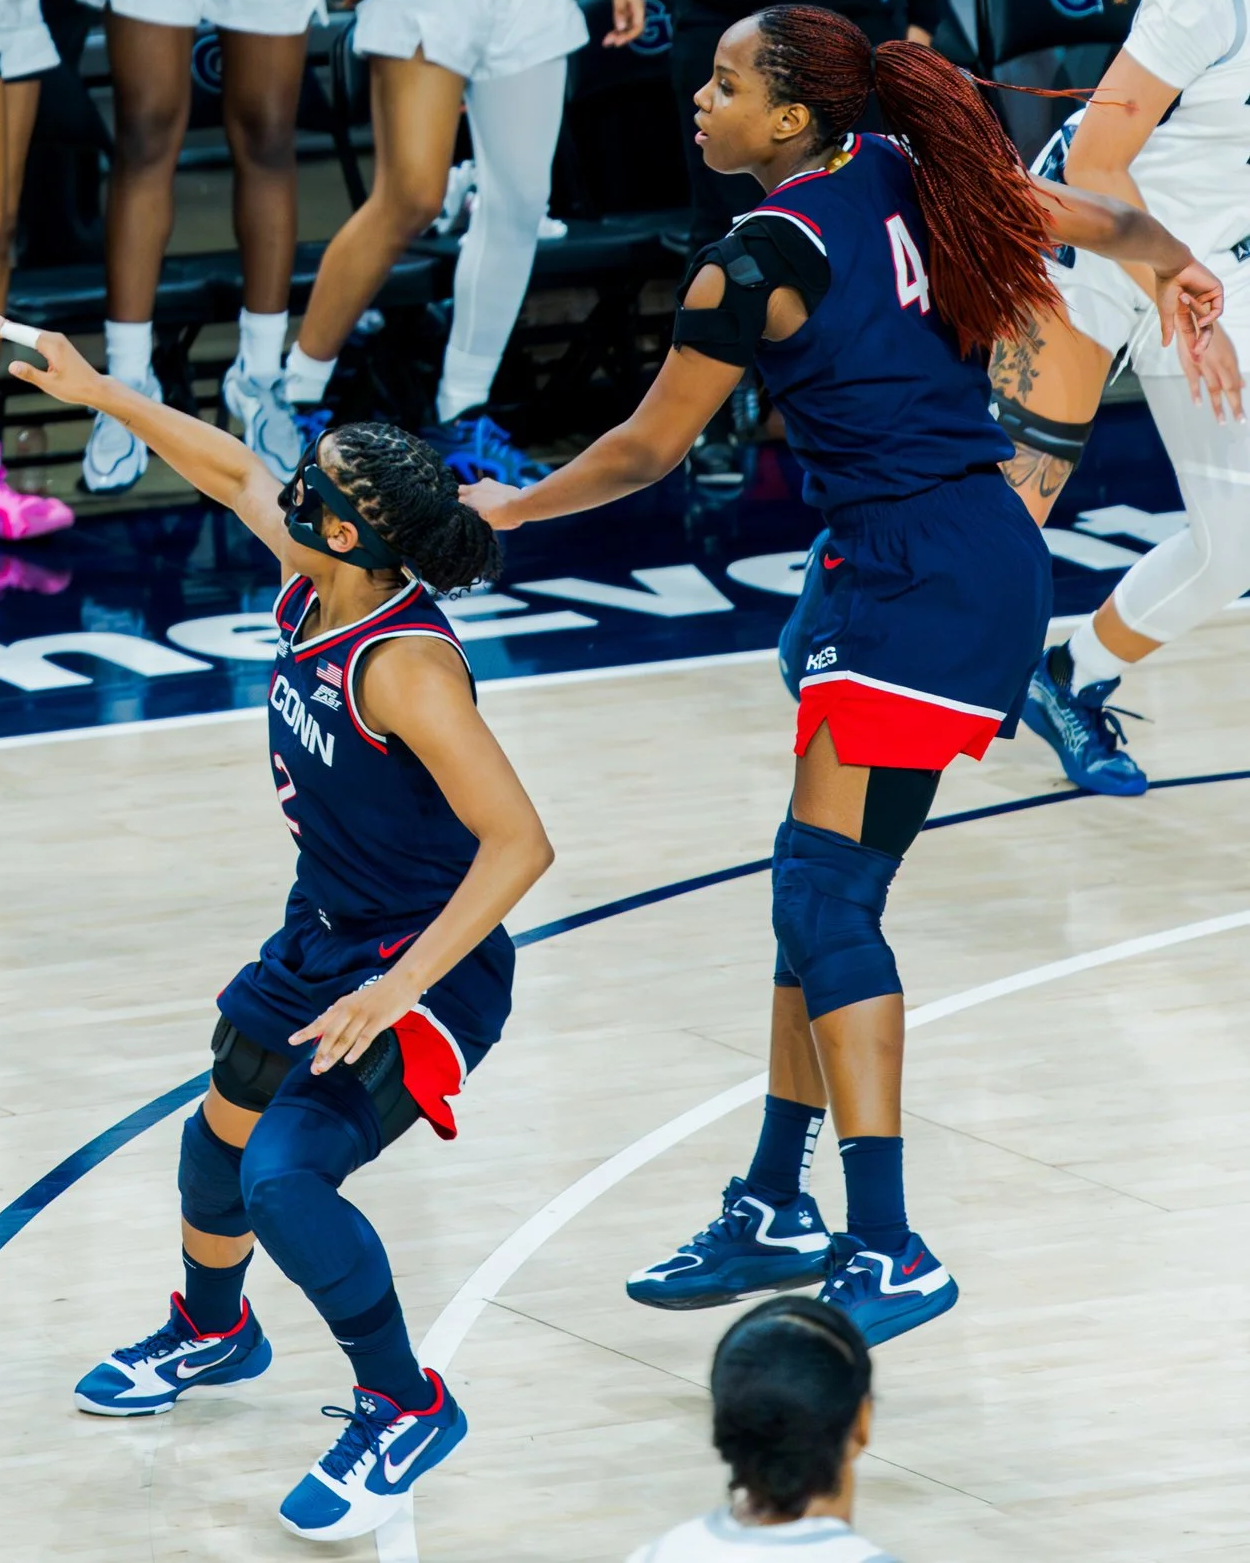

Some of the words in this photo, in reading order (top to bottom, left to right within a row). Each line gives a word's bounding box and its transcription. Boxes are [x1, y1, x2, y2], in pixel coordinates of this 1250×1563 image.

[883, 211, 932, 317] 4
[269, 670, 335, 768] CONN
[312, 690, 343, 709] EAST
[318, 684, 340, 699] BIG
[273, 751, 303, 837] 2
